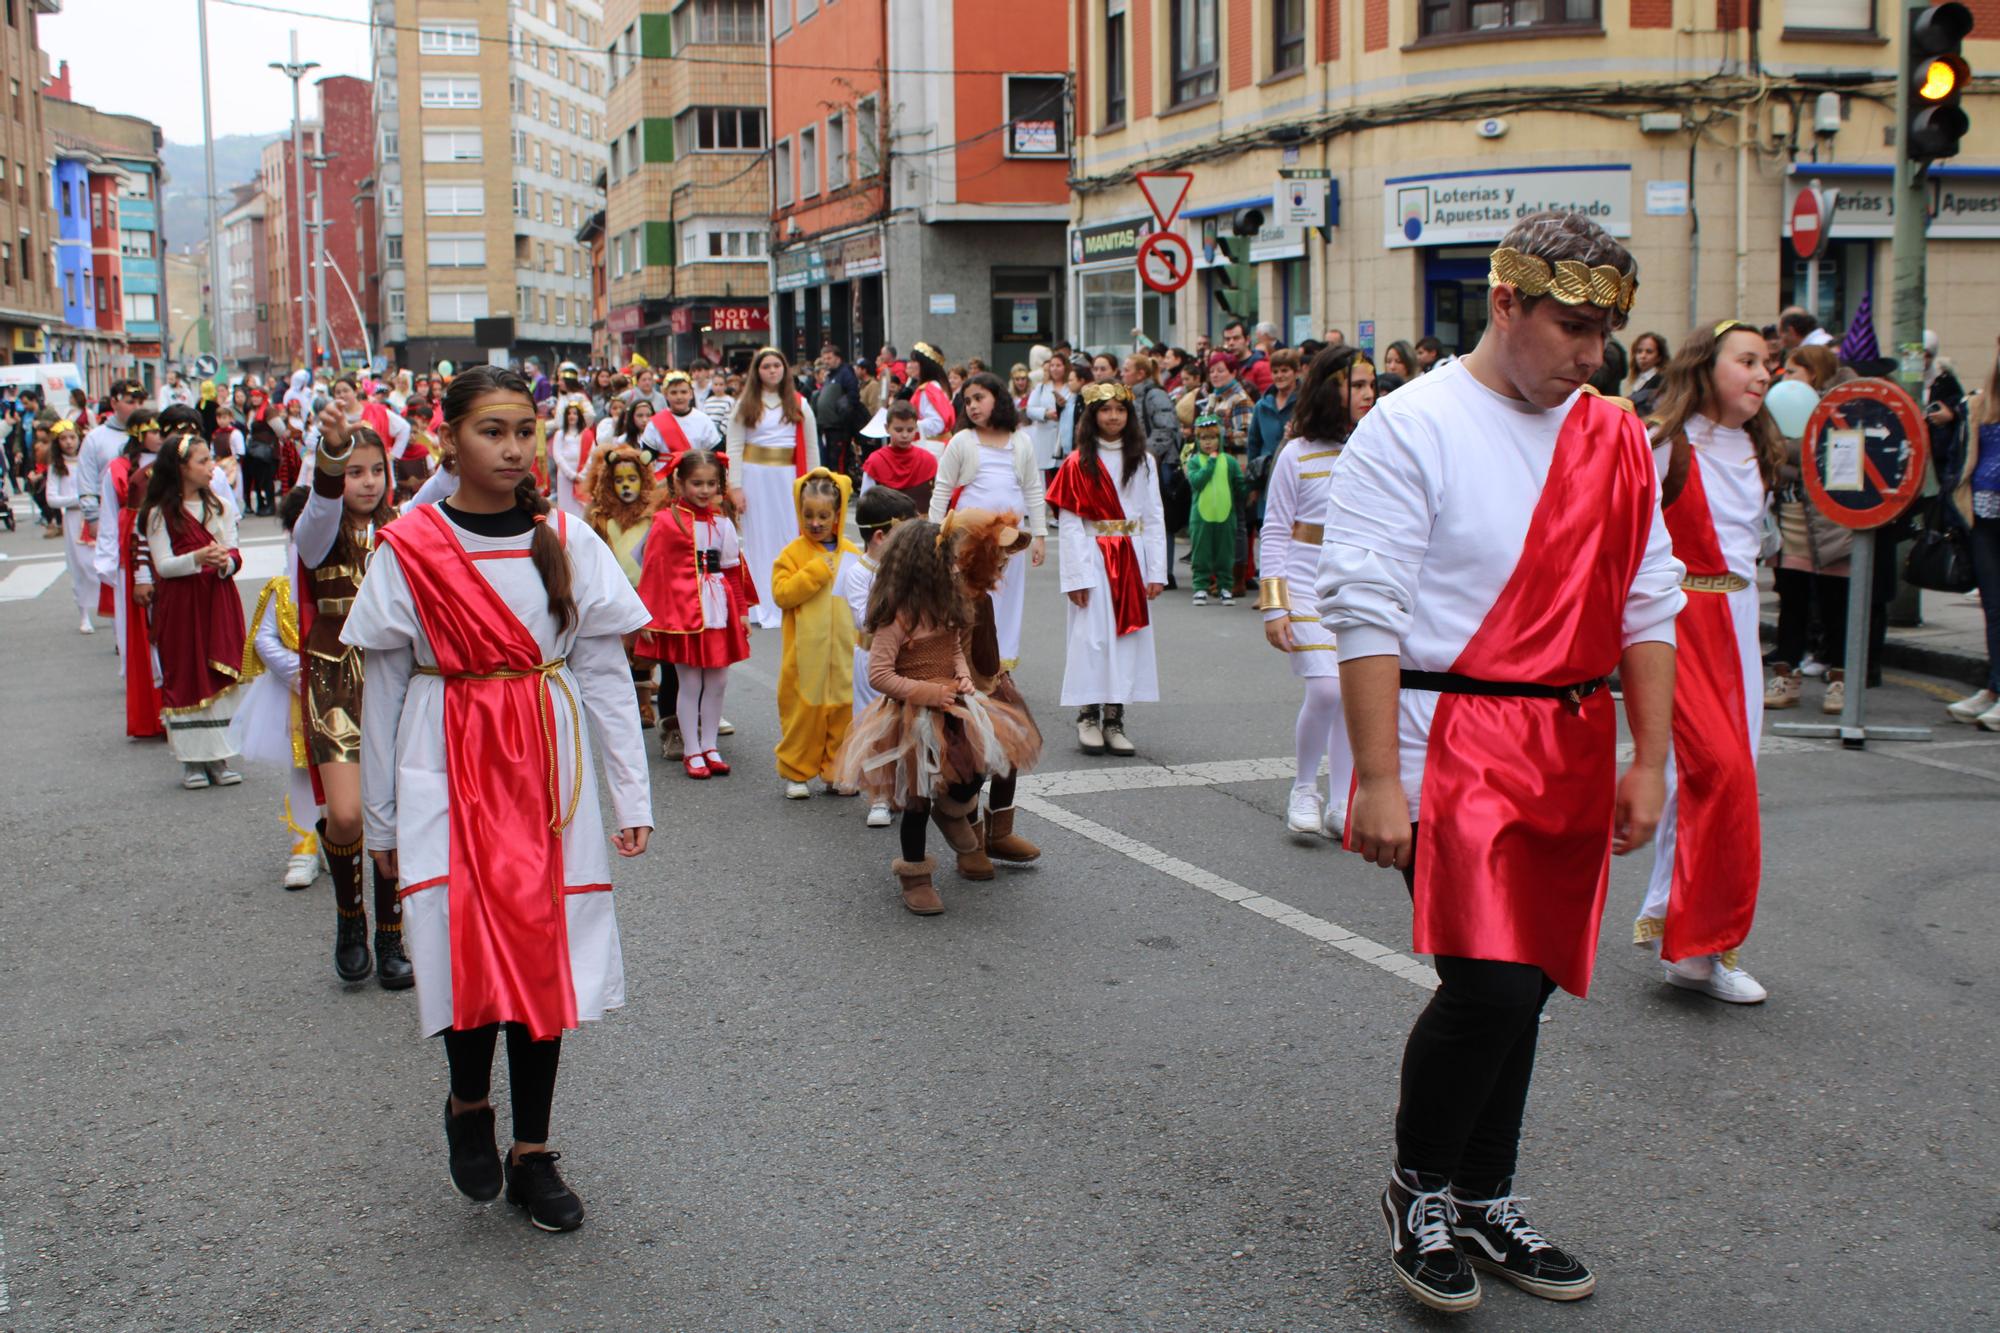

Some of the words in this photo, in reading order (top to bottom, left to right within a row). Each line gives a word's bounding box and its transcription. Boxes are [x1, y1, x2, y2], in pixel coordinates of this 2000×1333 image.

[1434, 185, 1500, 204] Loterías
[1505, 187, 1516, 204] y
[1835, 190, 1882, 210] erías
[1943, 192, 2000, 216] Apues
[1434, 206, 1510, 225] Apuestas
[1516, 202, 1542, 218] del
[1085, 228, 1135, 254] MANITAS
[714, 308, 760, 319] MODA
[714, 319, 751, 330] PIEL
